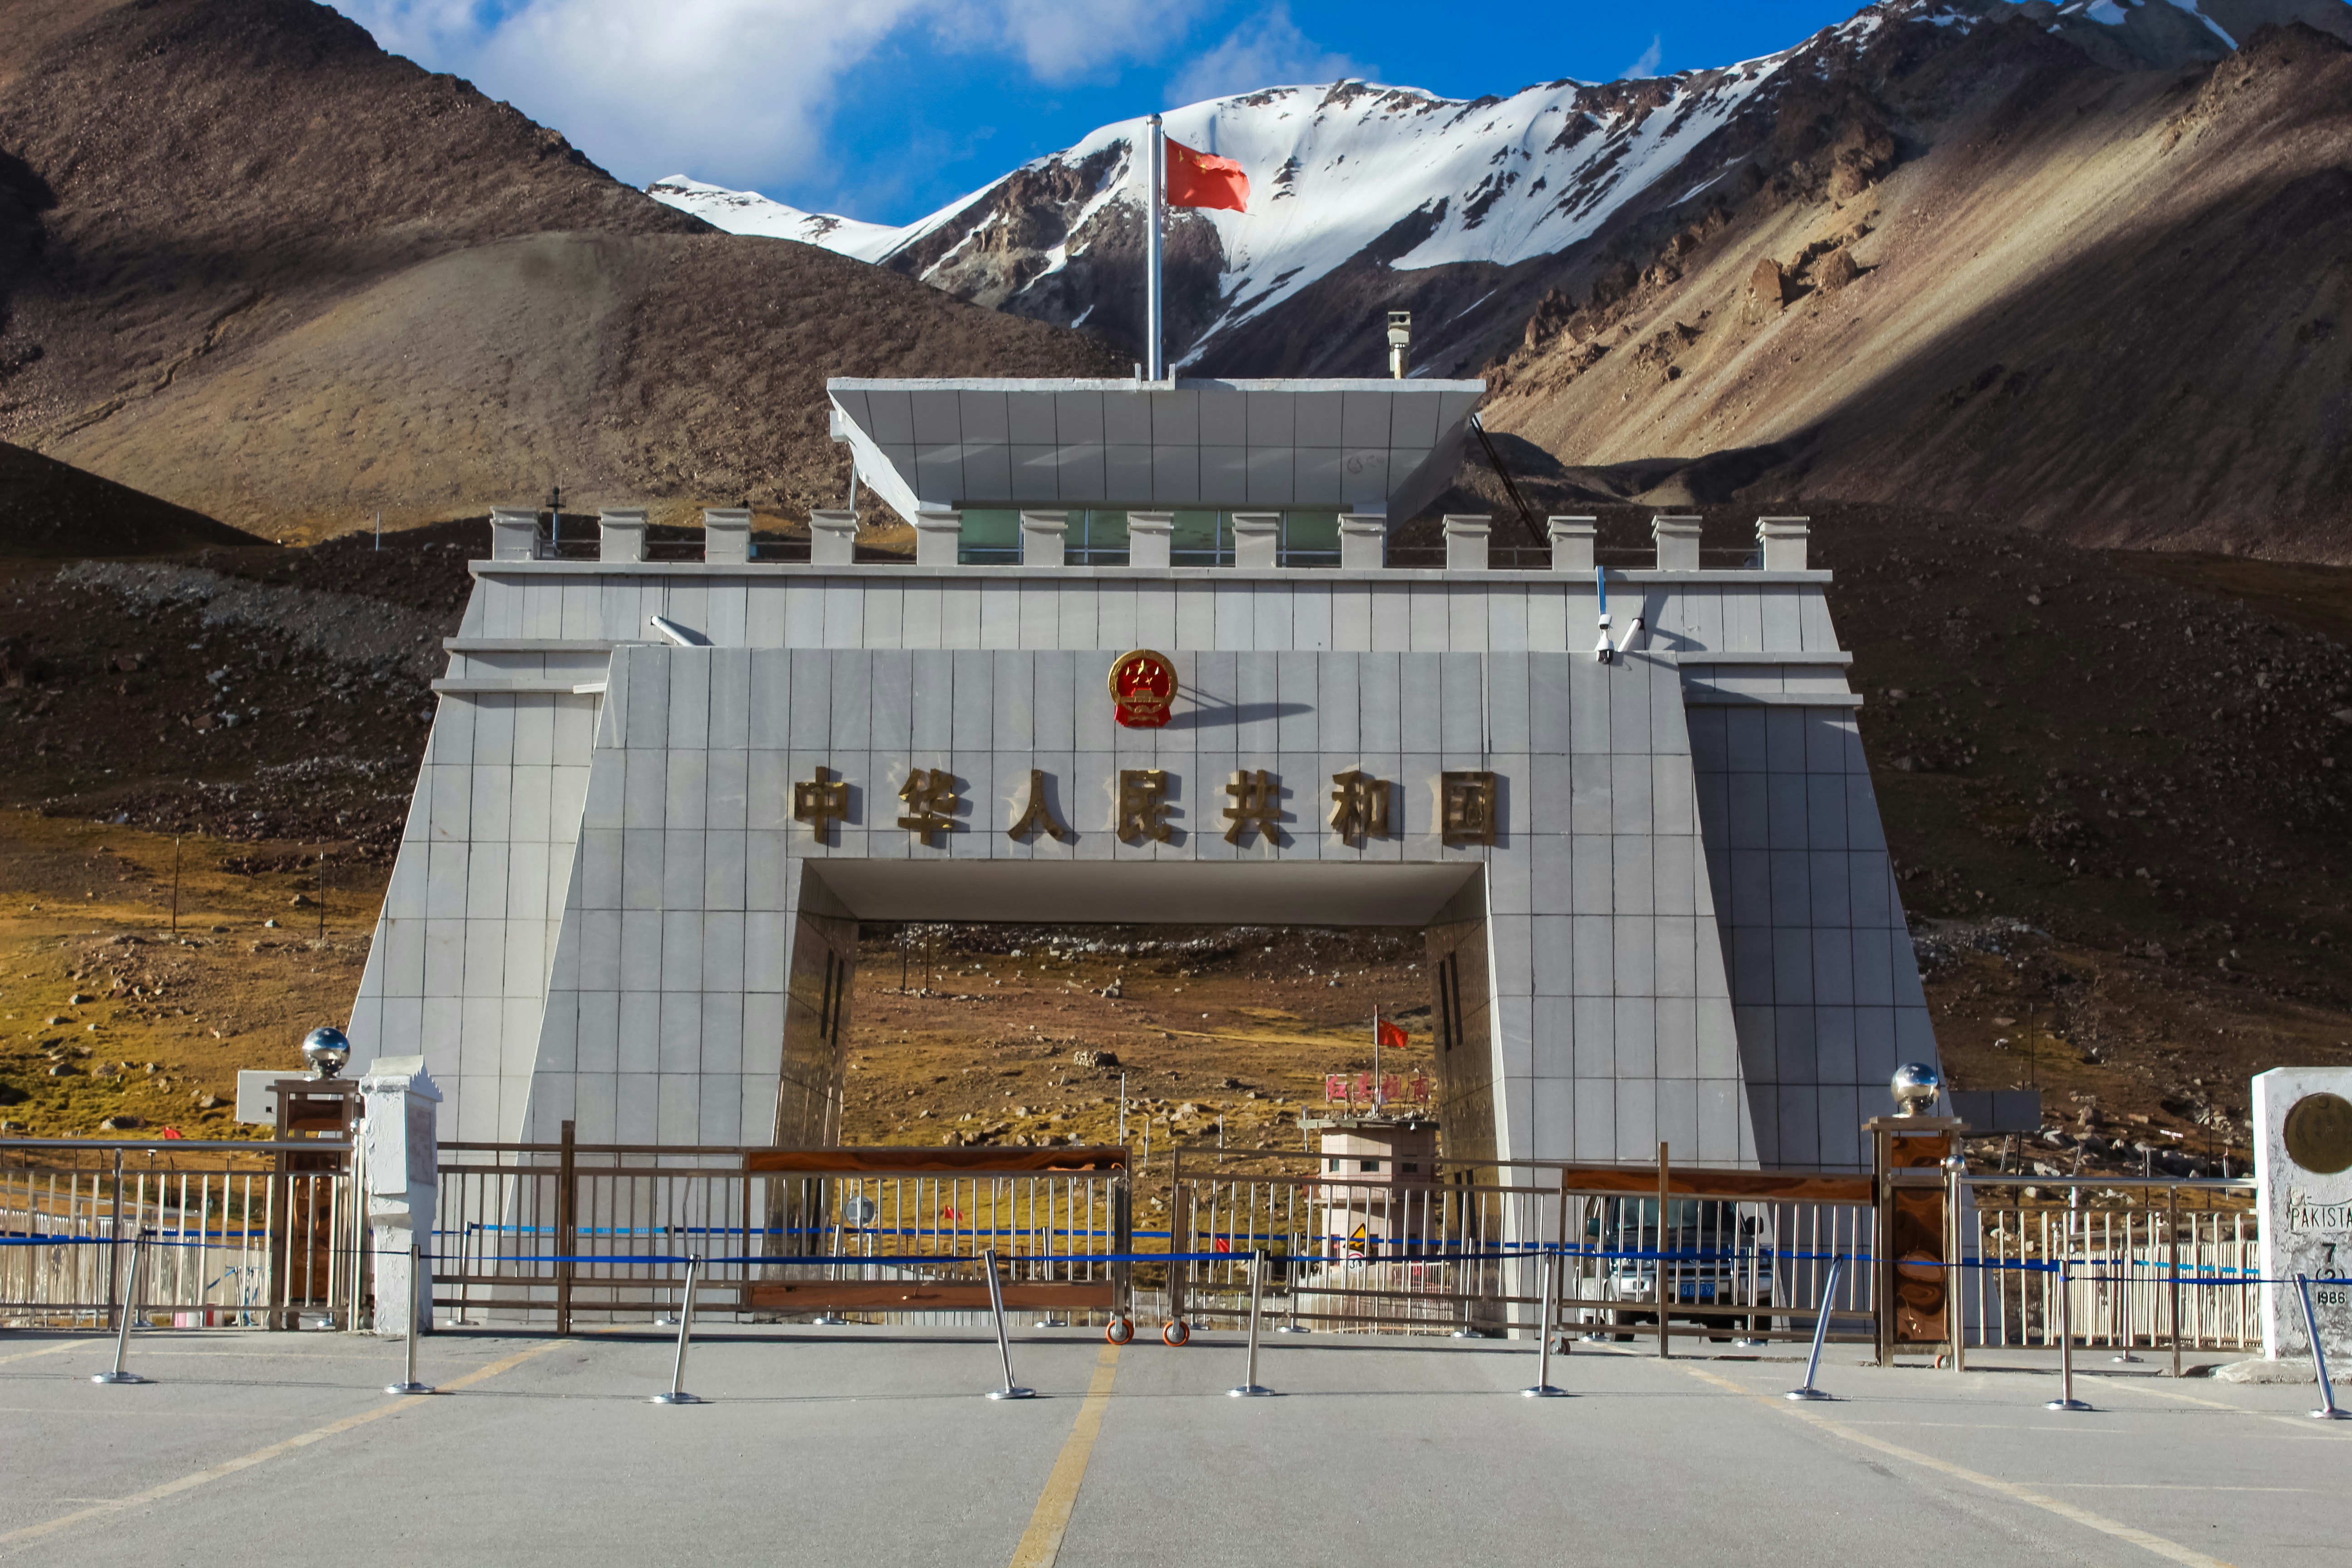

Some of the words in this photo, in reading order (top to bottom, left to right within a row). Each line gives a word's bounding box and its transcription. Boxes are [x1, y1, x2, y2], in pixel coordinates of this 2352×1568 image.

[794, 765, 1495, 847] 中华人民共和国
[2322, 1243, 2337, 1263] 7
[2317, 1292, 2346, 1304] 1986
